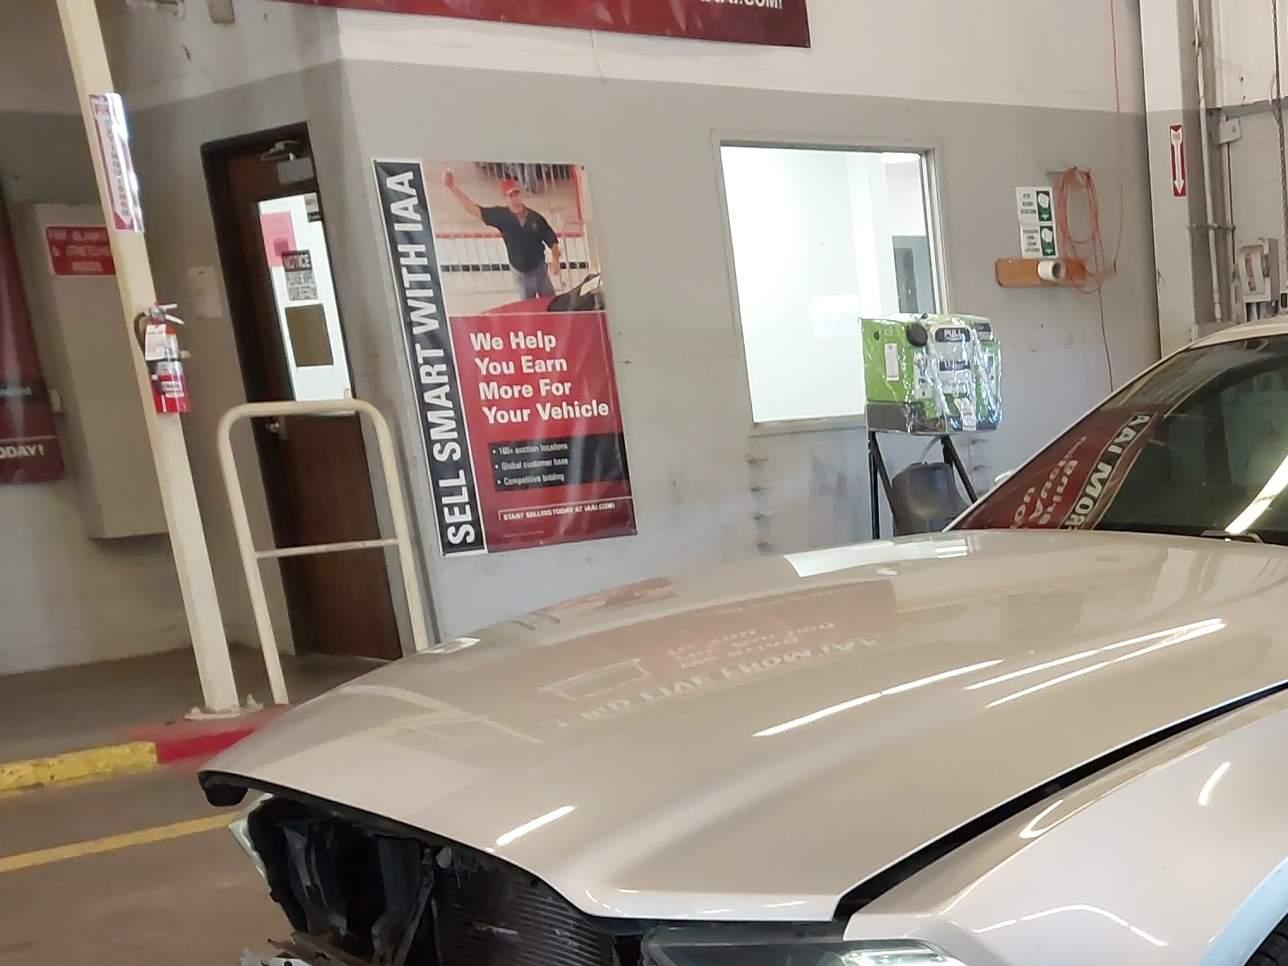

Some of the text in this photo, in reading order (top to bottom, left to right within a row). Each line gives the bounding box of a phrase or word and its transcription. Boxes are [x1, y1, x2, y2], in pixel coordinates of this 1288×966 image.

[283, 254, 311, 269] NOTICE
[470, 331, 556, 351] We Help
[386, 171, 475, 544] SELL SMART WITH IAA
[474, 355, 567, 375] You Earn
[479, 379, 572, 400] More For
[482, 400, 609, 425] Your Vehicle
[0, 444, 44, 459] ODAY!
[515, 445, 539, 454] auction
[541, 443, 568, 452] locations
[501, 462, 522, 470] Global
[523, 459, 552, 469] customer
[503, 473, 564, 485] Competitive bidding
[553, 507, 573, 516] TODAY
